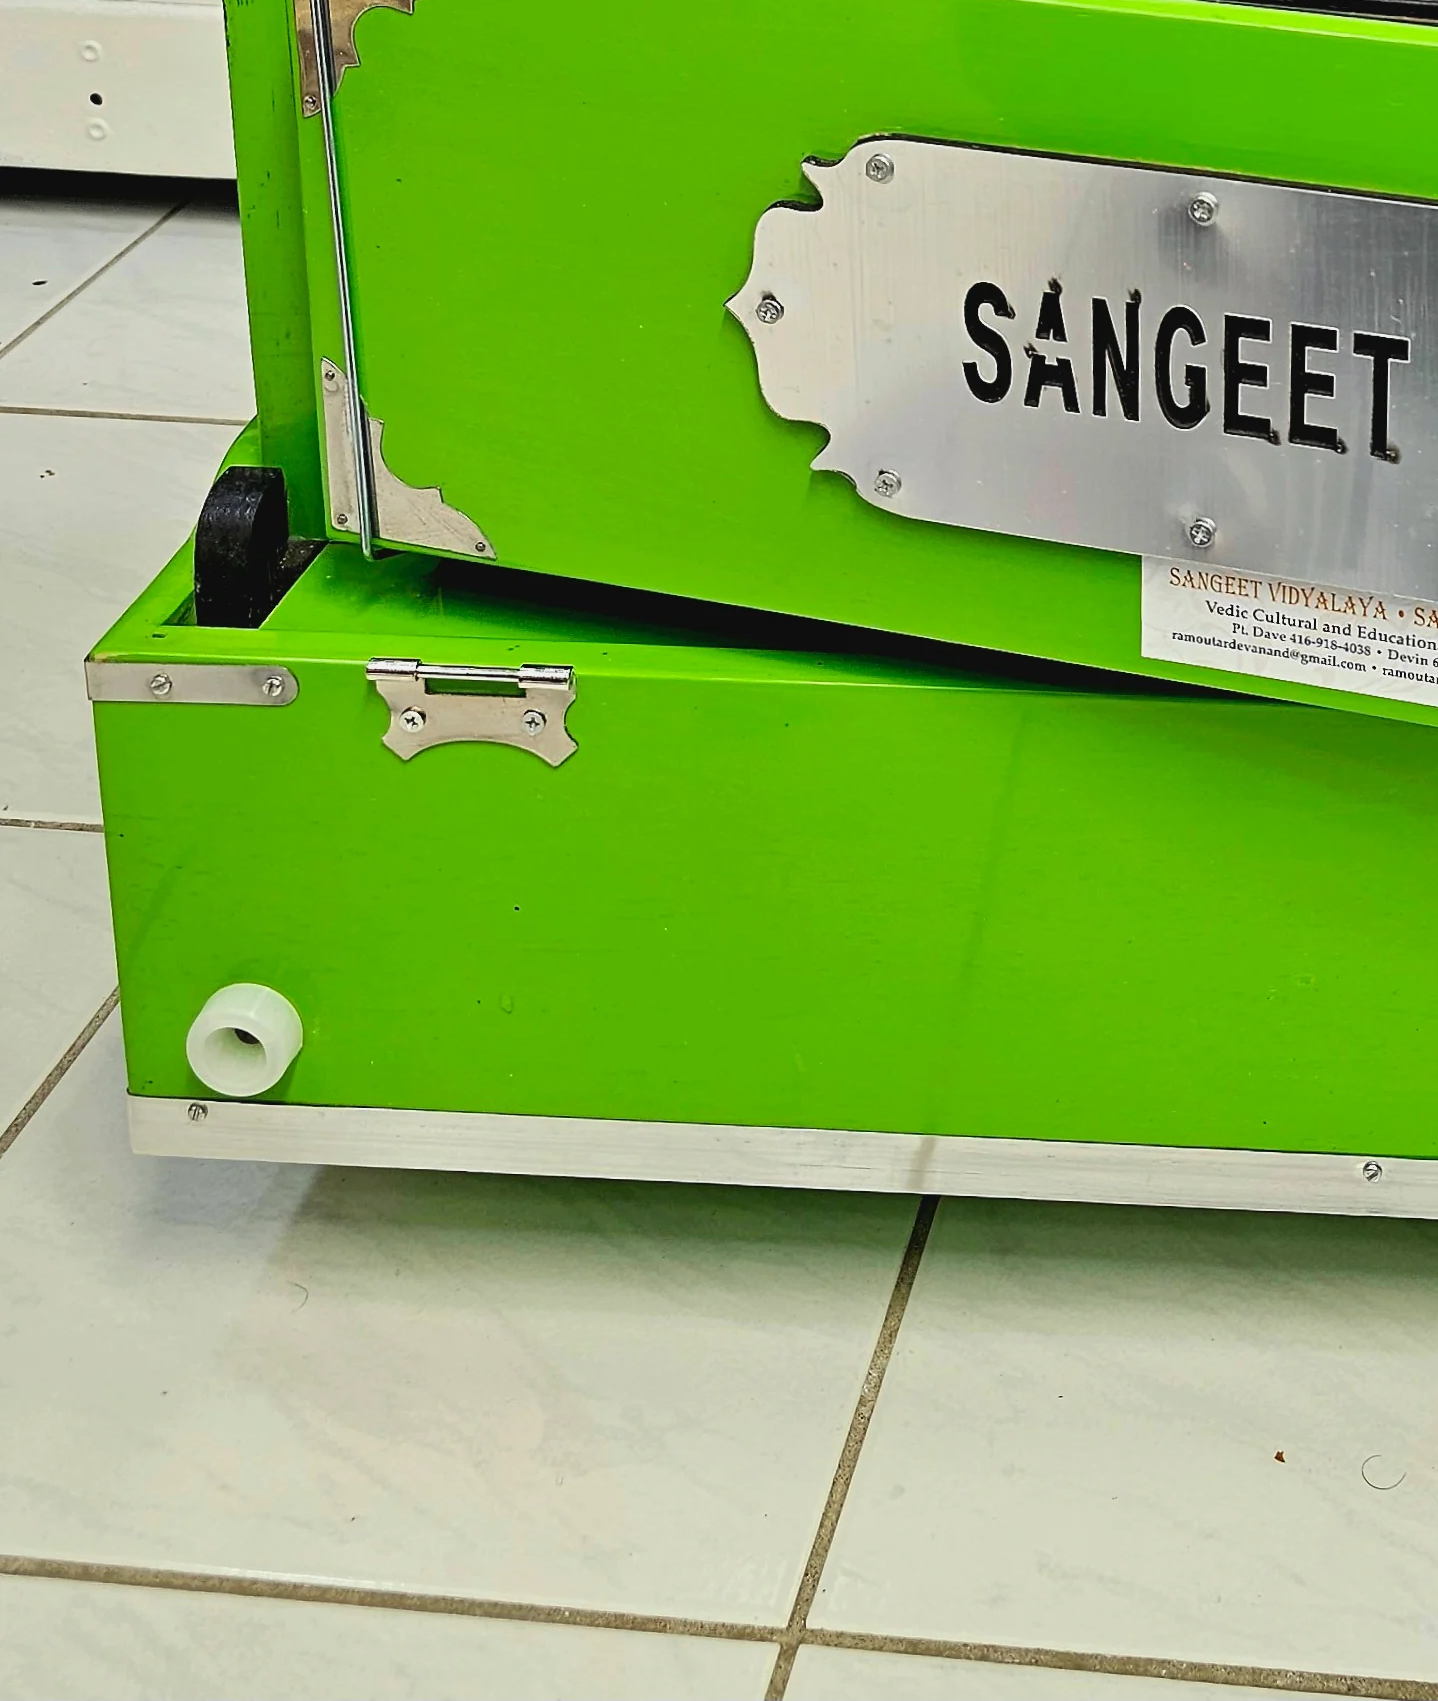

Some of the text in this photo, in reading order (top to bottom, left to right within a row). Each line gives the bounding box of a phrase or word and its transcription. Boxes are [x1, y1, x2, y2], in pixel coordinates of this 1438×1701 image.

[962, 278, 1412, 464] SANGEET
[1169, 567, 1263, 599] SANGEET
[1268, 581, 1388, 621] VIDYALAYA
[1205, 600, 1249, 620] Vedic
[1252, 608, 1318, 632] Cultural
[1321, 621, 1352, 637] and
[1171, 631, 1368, 673] ramoutardevanand@gmail.com
[1232, 622, 1249, 636] Pt.
[1253, 626, 1287, 642] Dave
[1289, 633, 1372, 657] 416-918-4038
[1387, 648, 1429, 667] Devin
